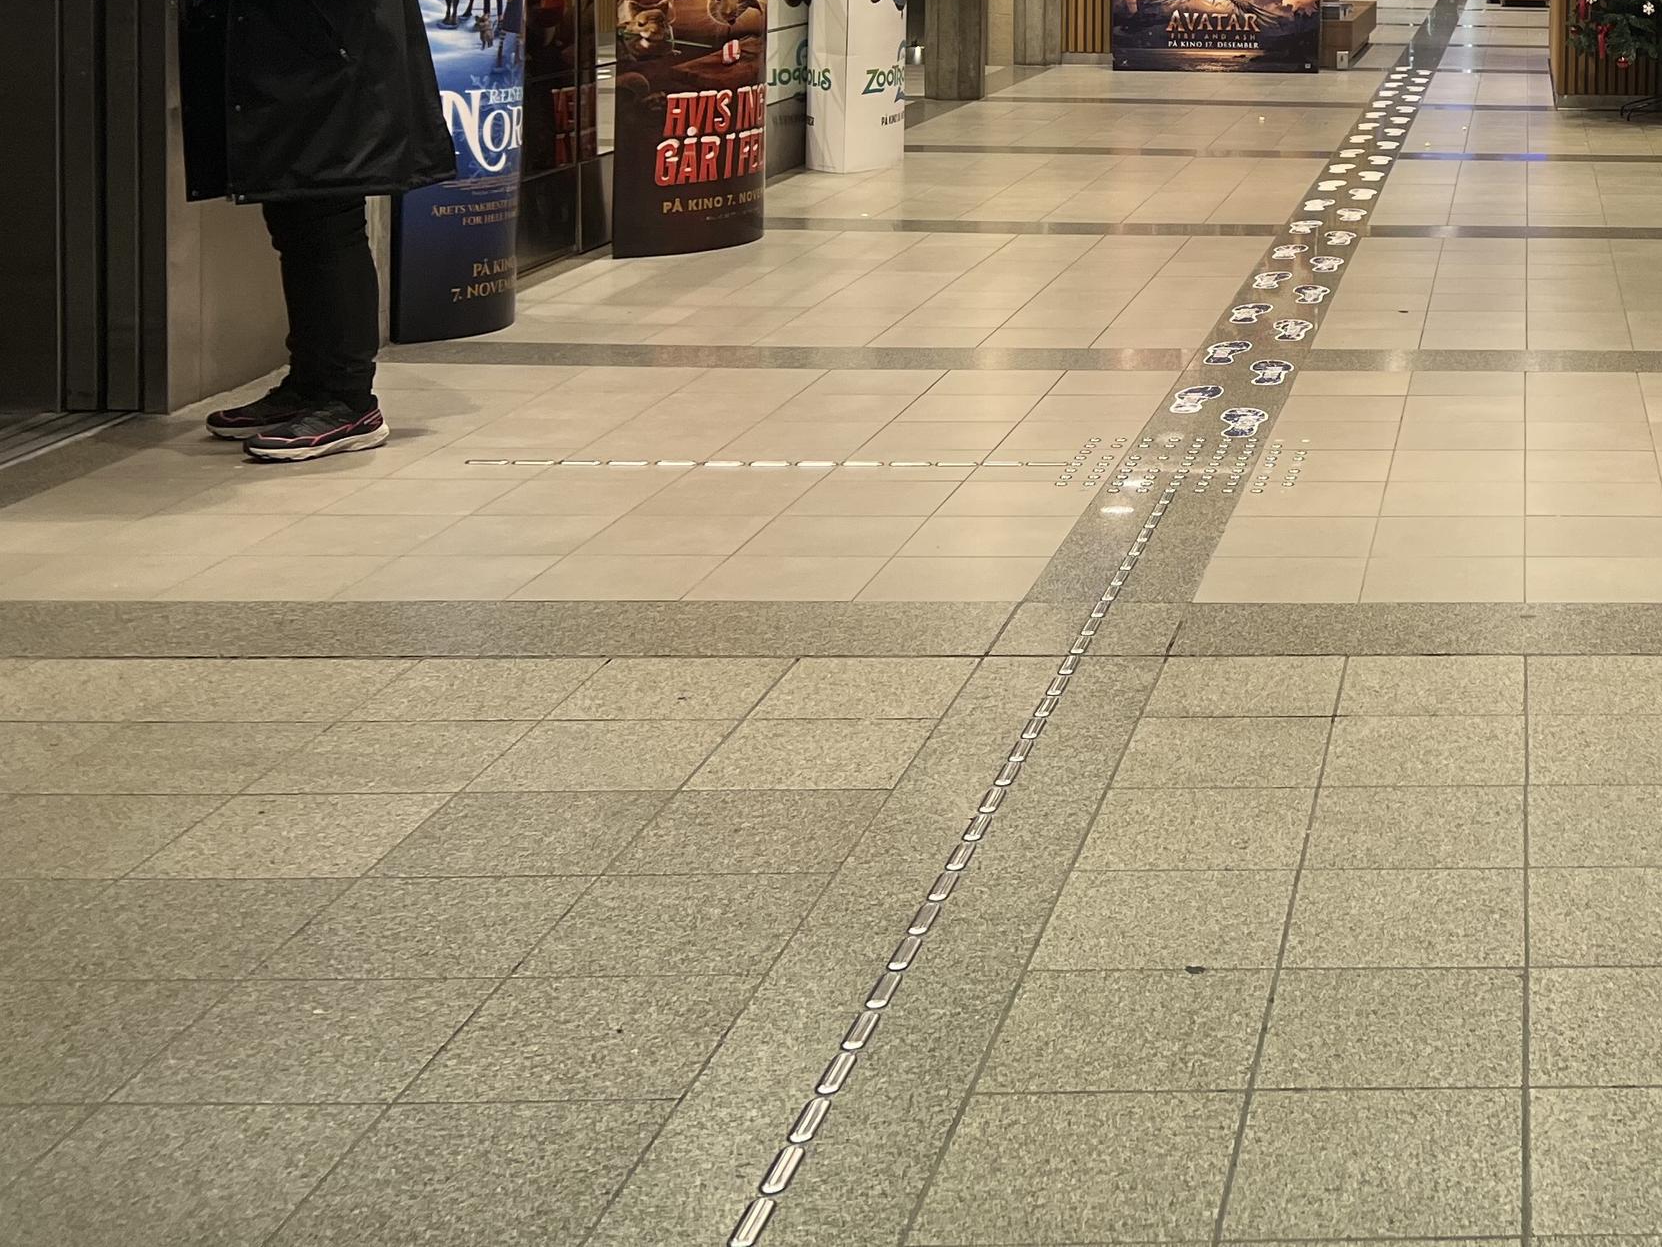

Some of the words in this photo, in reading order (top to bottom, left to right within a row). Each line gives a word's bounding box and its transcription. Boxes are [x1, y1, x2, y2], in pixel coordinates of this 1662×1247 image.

[1166, 9, 1261, 32] AVATAR
[1168, 40, 1178, 48] PÅ
[1217, 41, 1260, 49] DESEMBER
[663, 90, 732, 137] HVIS
[655, 126, 721, 186] GÅR
[723, 132, 736, 179] I
[431, 203, 466, 216] ÅRETS
[662, 197, 683, 213] PÅ
[688, 195, 723, 210] KINO
[726, 193, 737, 206] 7.
[473, 258, 491, 277] PÅ
